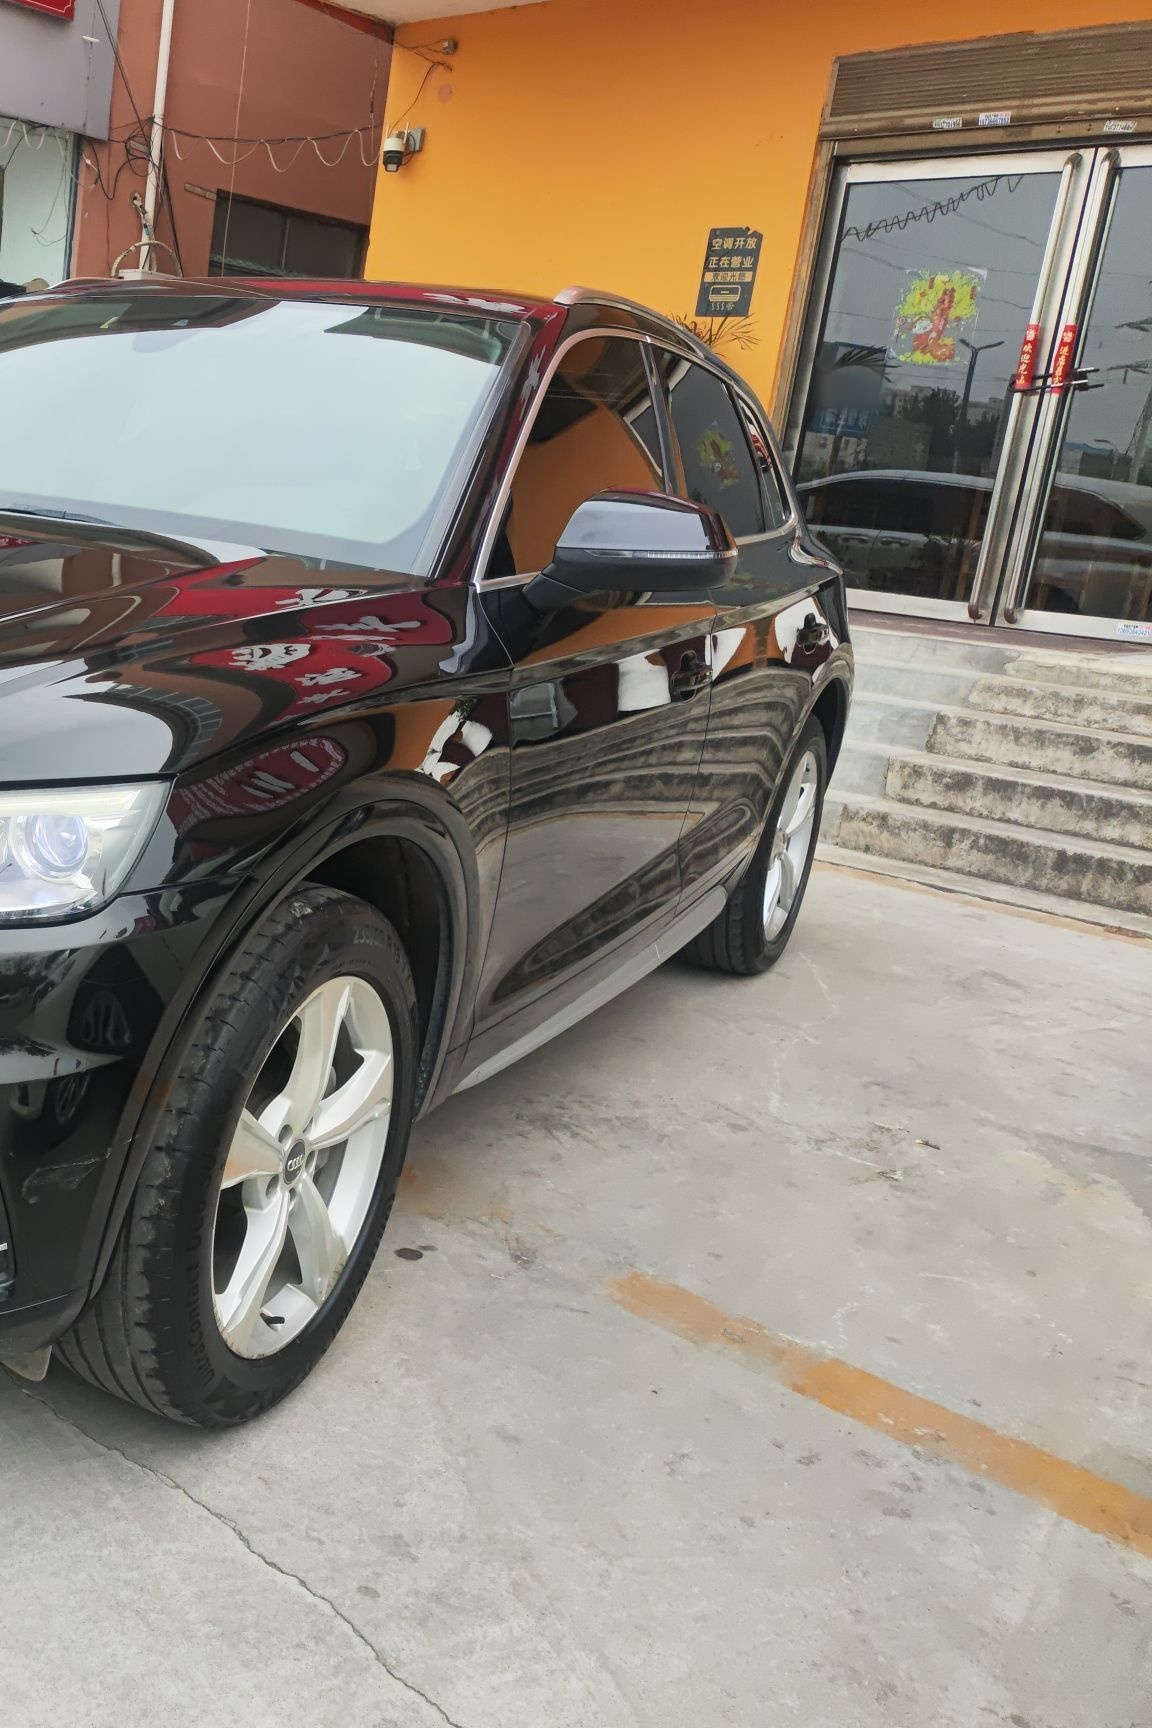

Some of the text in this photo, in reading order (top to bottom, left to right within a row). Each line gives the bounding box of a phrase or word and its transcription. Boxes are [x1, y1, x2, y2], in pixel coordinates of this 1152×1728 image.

[711, 237, 757, 250] 空调开放
[708, 256, 754, 268] 正在营业
